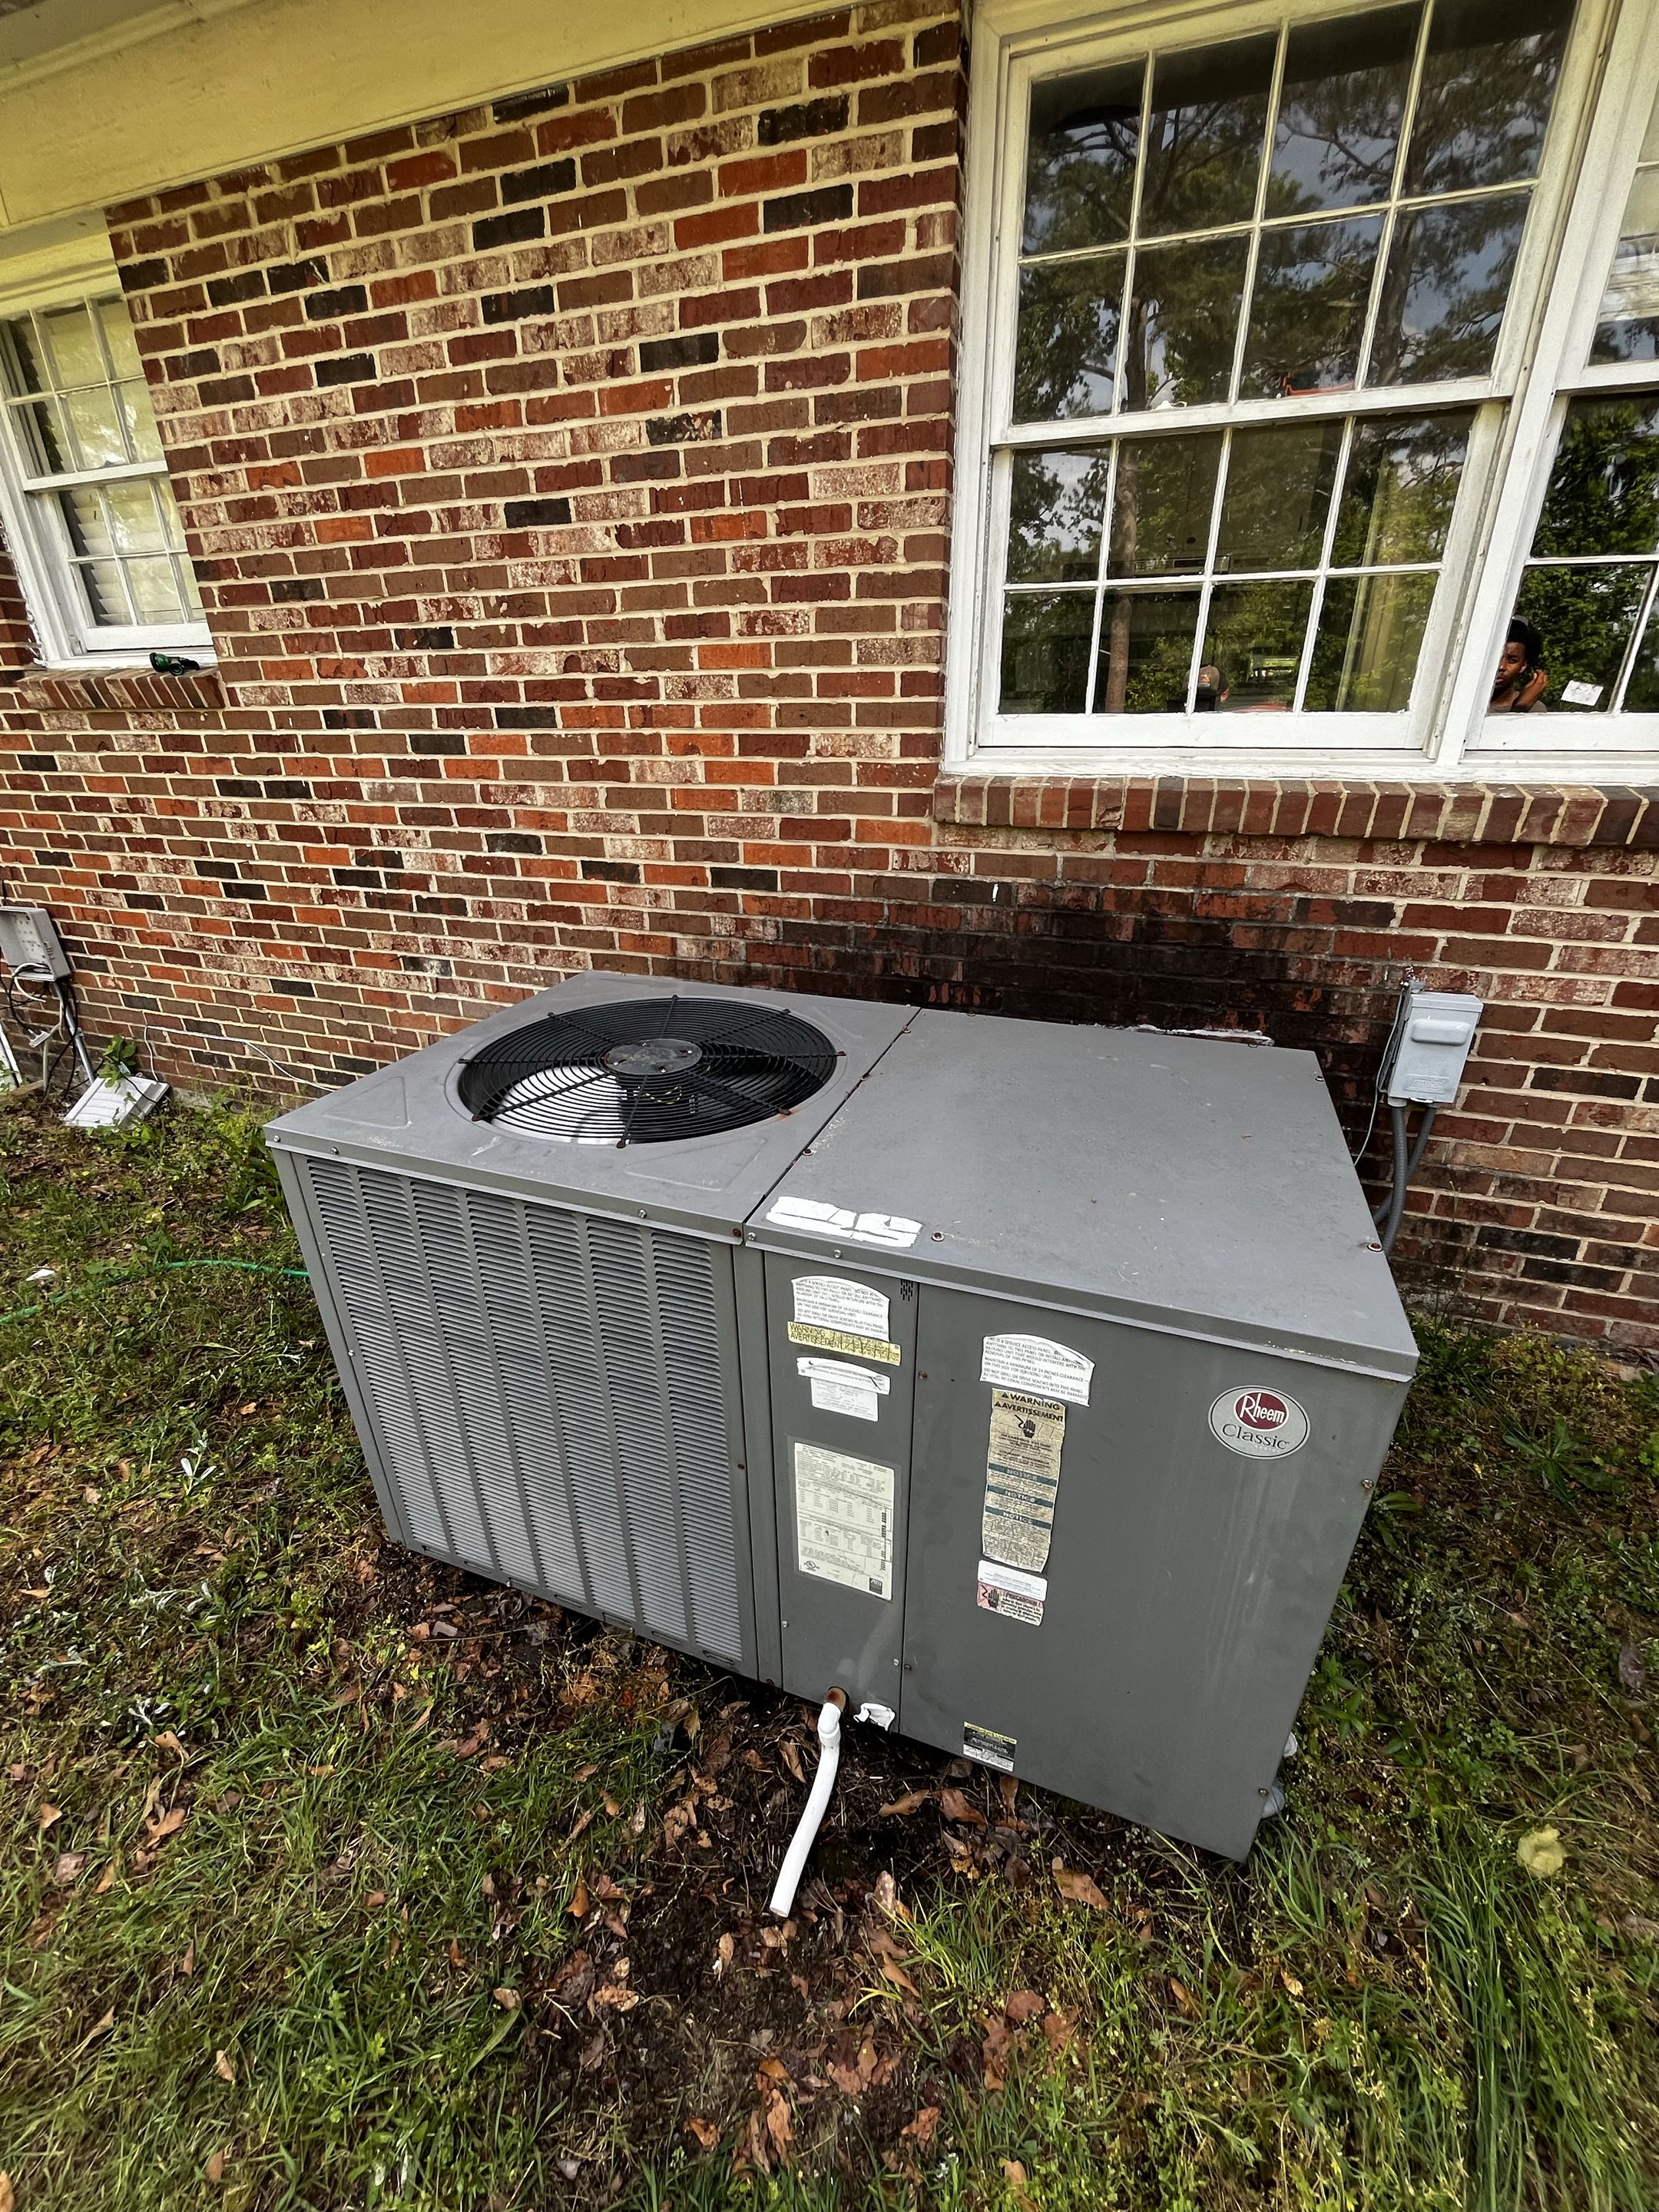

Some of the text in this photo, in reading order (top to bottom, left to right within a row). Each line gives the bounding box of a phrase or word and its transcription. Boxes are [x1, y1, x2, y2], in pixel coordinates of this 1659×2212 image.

[790, 1322, 826, 1337] WARNING
[1010, 1392, 1060, 1411] WARNING
[1240, 1392, 1285, 1424] Rheem
[1002, 1403, 1063, 1422] AVERTISSEMENT
[1222, 1423, 1286, 1450] Classic
